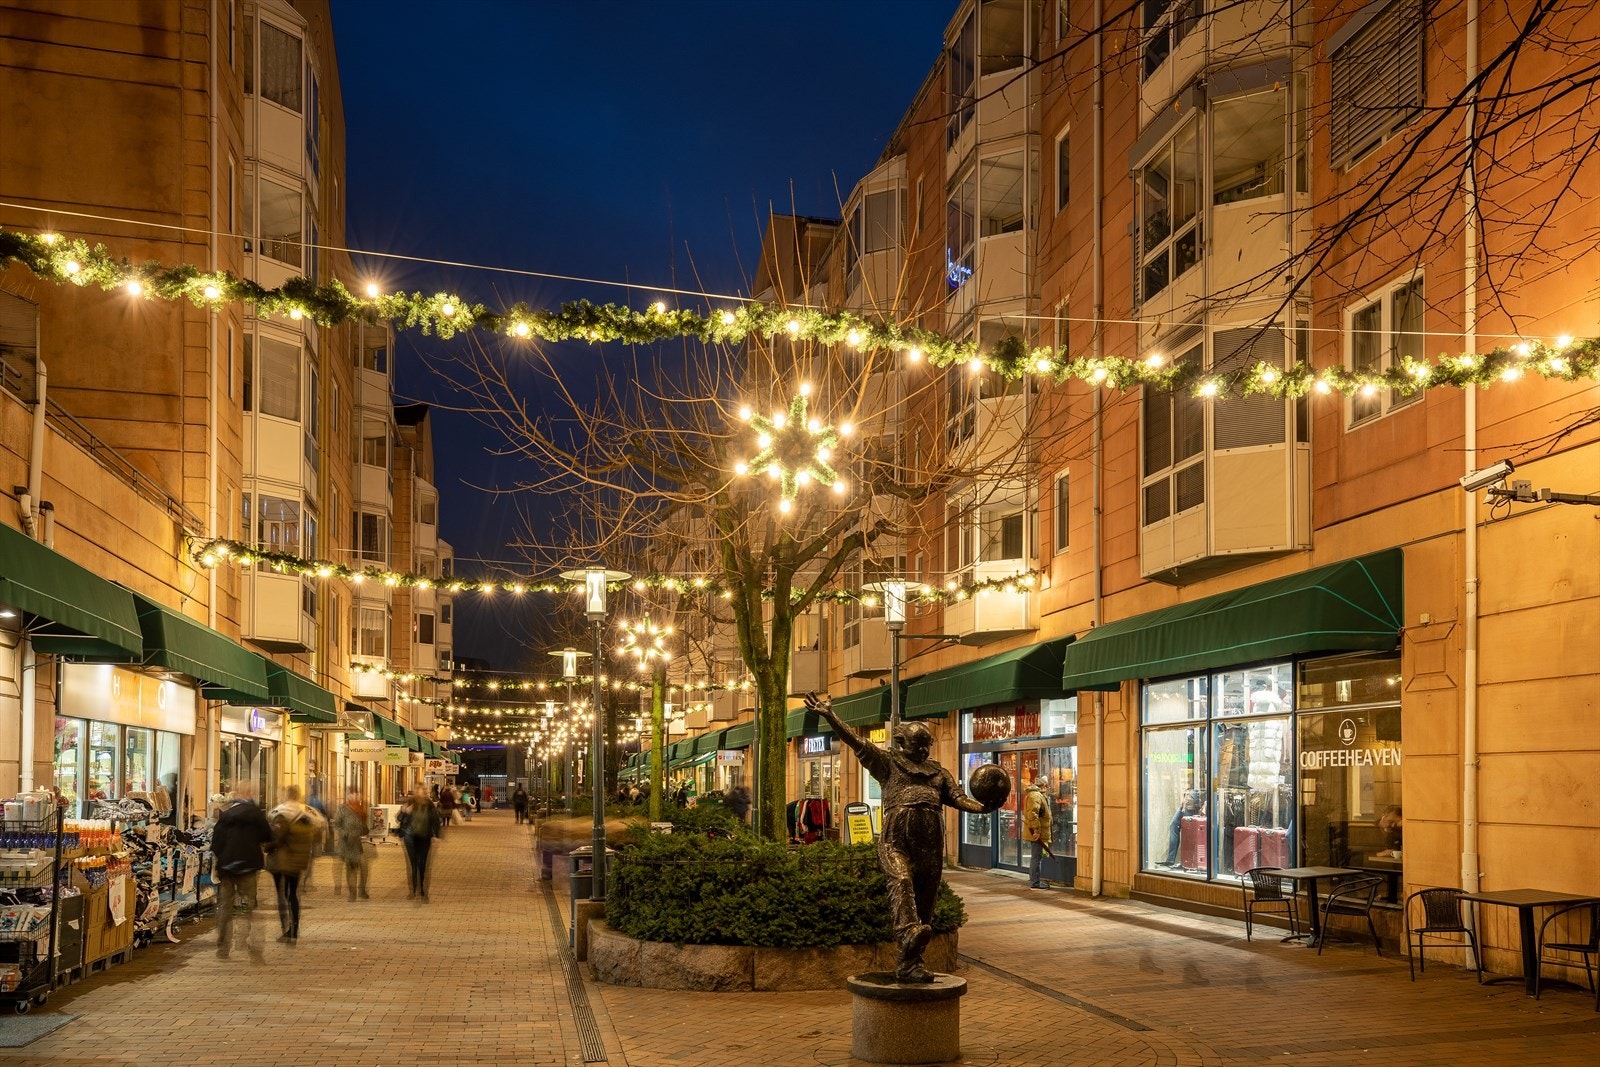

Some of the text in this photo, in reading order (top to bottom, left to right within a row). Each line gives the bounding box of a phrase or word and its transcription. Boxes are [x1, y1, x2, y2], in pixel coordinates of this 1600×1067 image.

[1300, 748, 1402, 768] COFFEEHEAVEN
[1003, 761, 1016, 771] SALE
[1024, 760, 1038, 770] SALE
